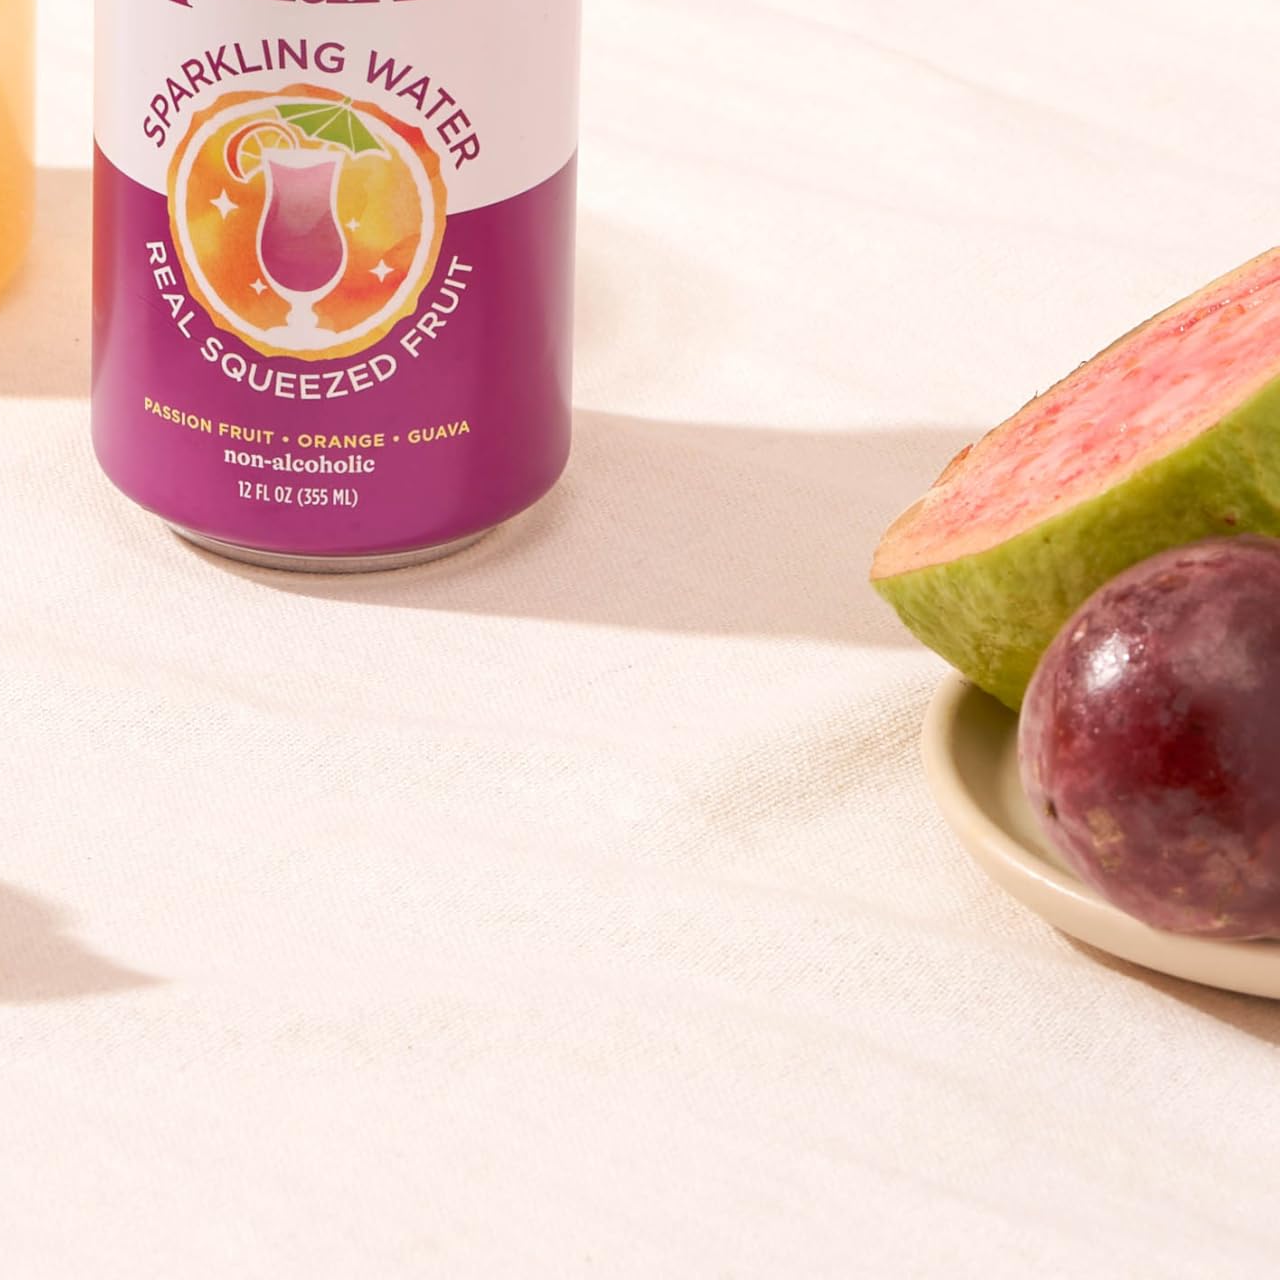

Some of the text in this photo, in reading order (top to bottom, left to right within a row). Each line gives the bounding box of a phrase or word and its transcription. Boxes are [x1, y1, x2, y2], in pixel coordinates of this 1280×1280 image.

[142, 37, 481, 169] SPARKLING WATER
[146, 240, 473, 401] REAL SQUEEZED FRUIT
[144, 397, 471, 449] PASSION FRUIT ORANGE GUAVA
[223, 447, 376, 474] non-alcoholic
[238, 480, 358, 508] 12 FL OZ (355 ML)
